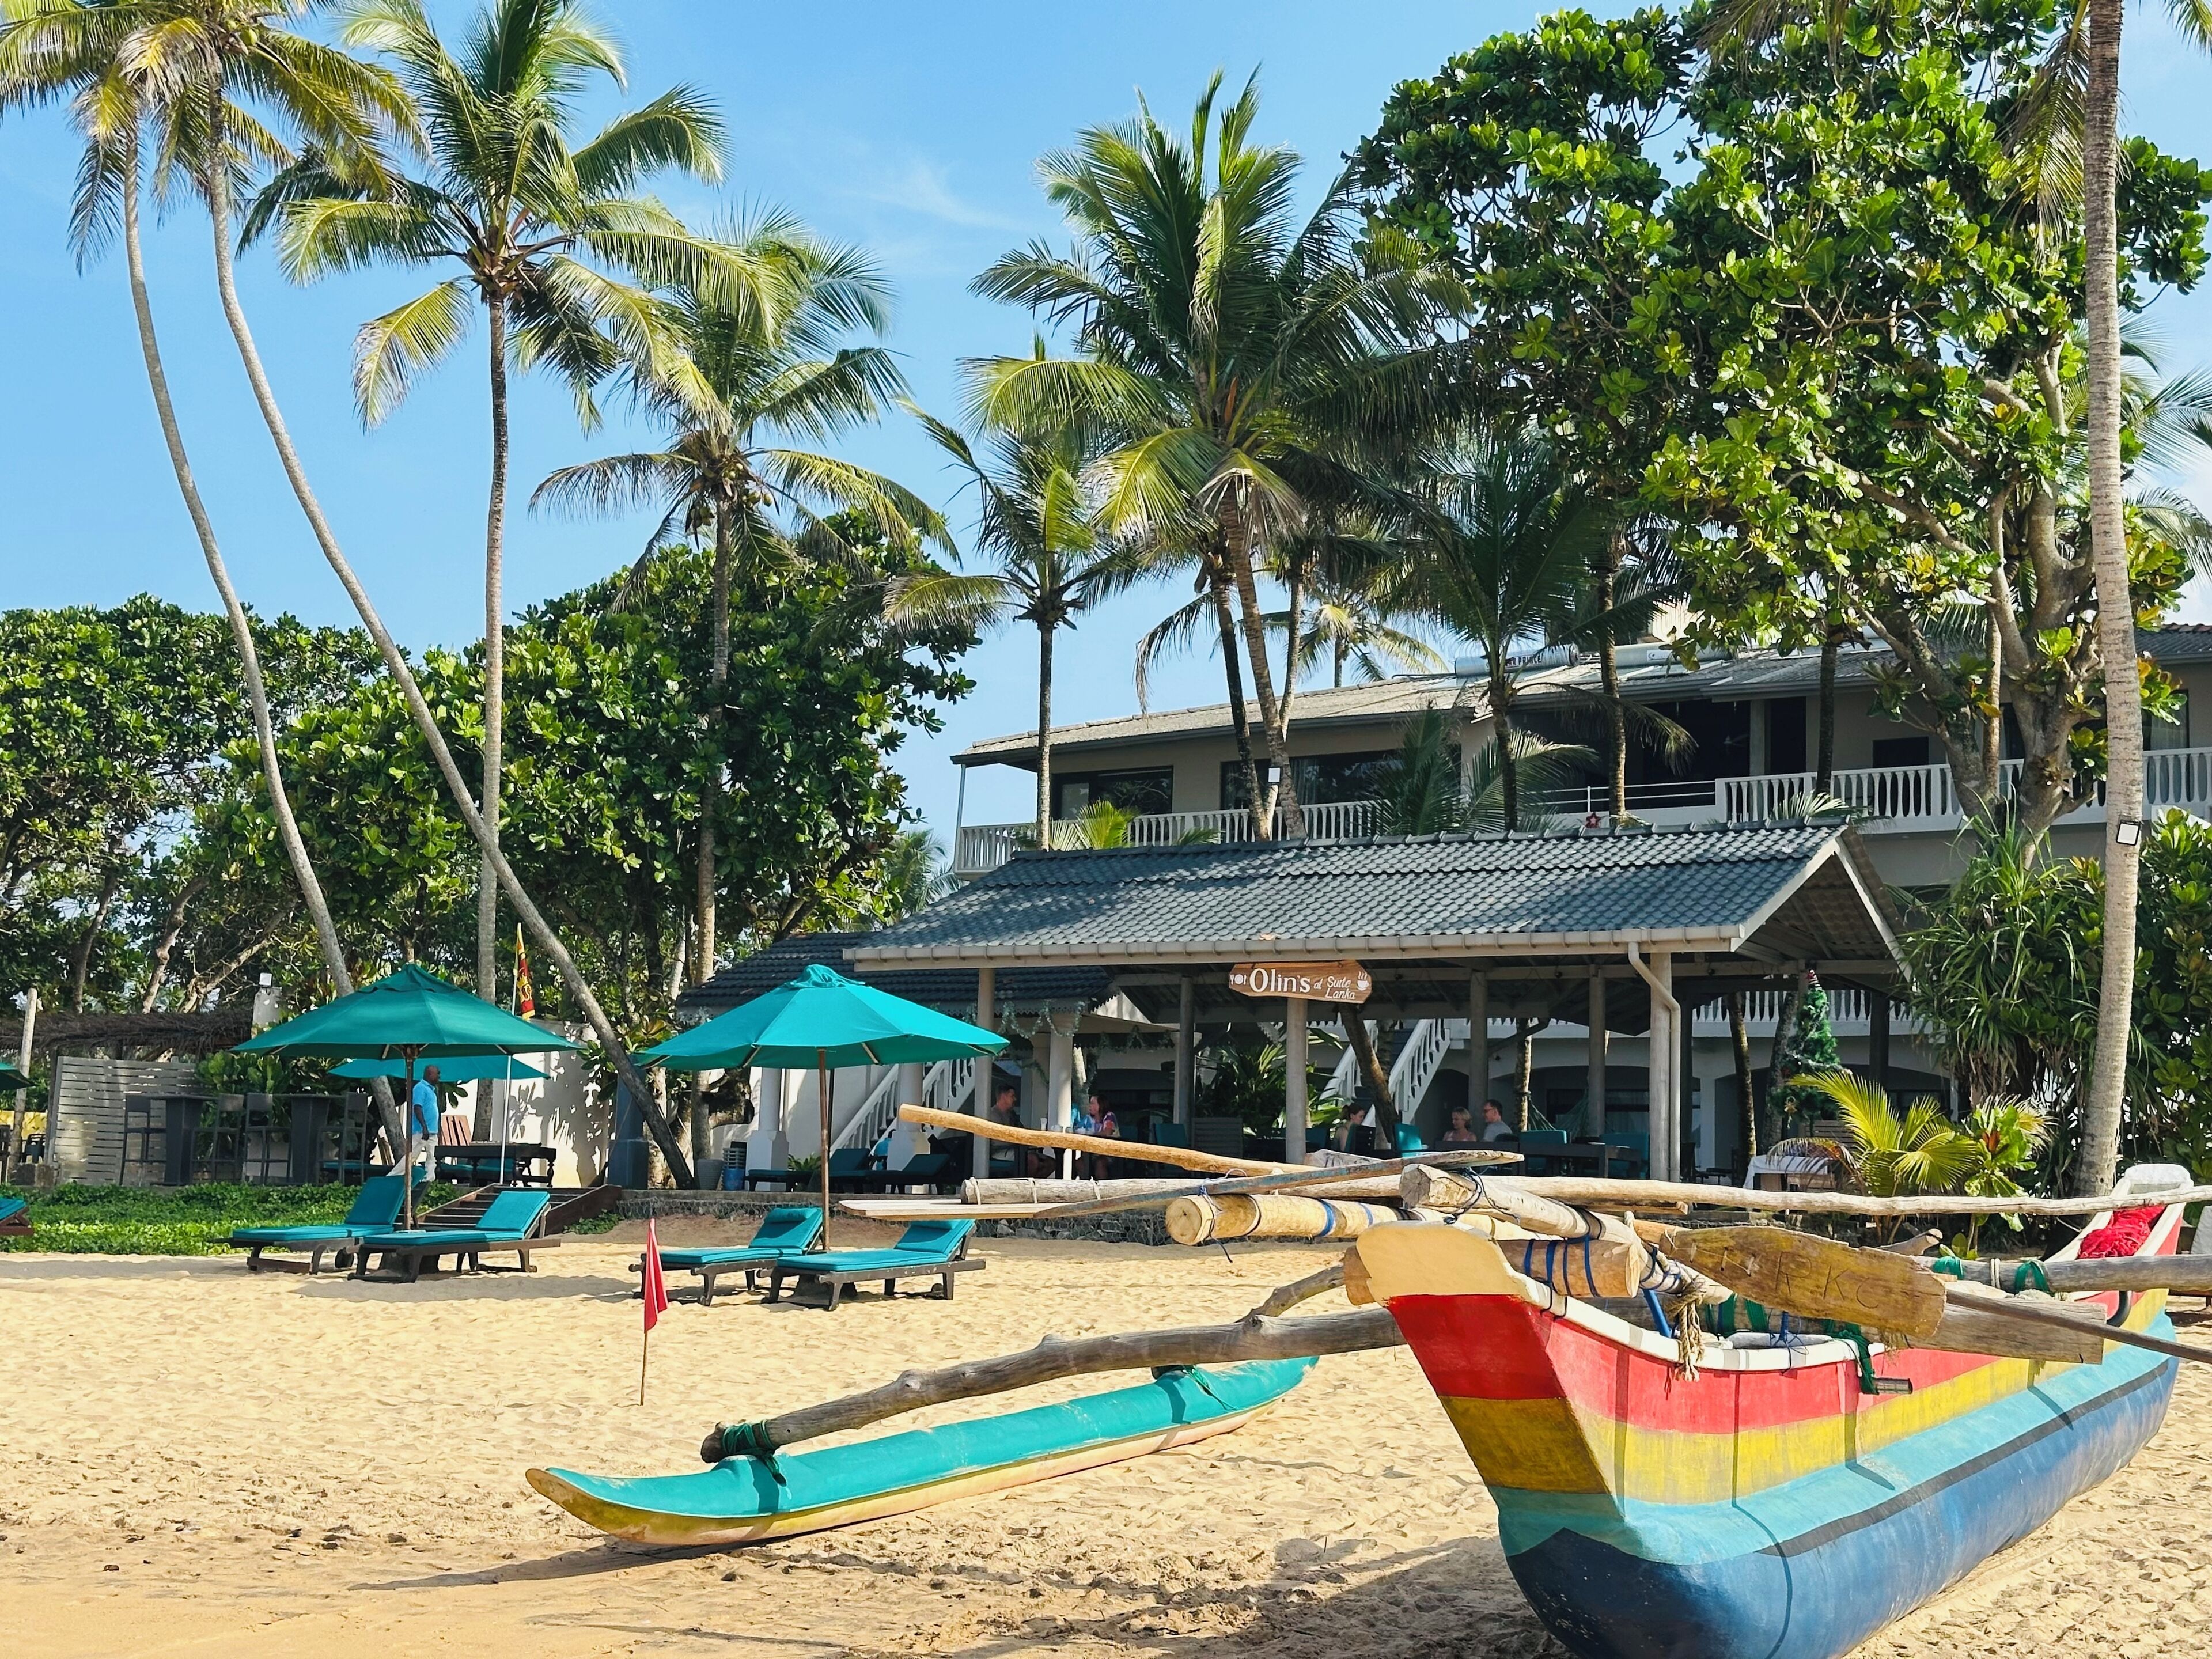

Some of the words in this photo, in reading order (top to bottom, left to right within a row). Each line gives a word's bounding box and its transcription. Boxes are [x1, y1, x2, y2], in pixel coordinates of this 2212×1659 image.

[1249, 968, 1310, 993] Olin's
[1313, 978, 1323, 990] at
[1327, 976, 1351, 988] Suite
[1325, 987, 1355, 999] Lanka
